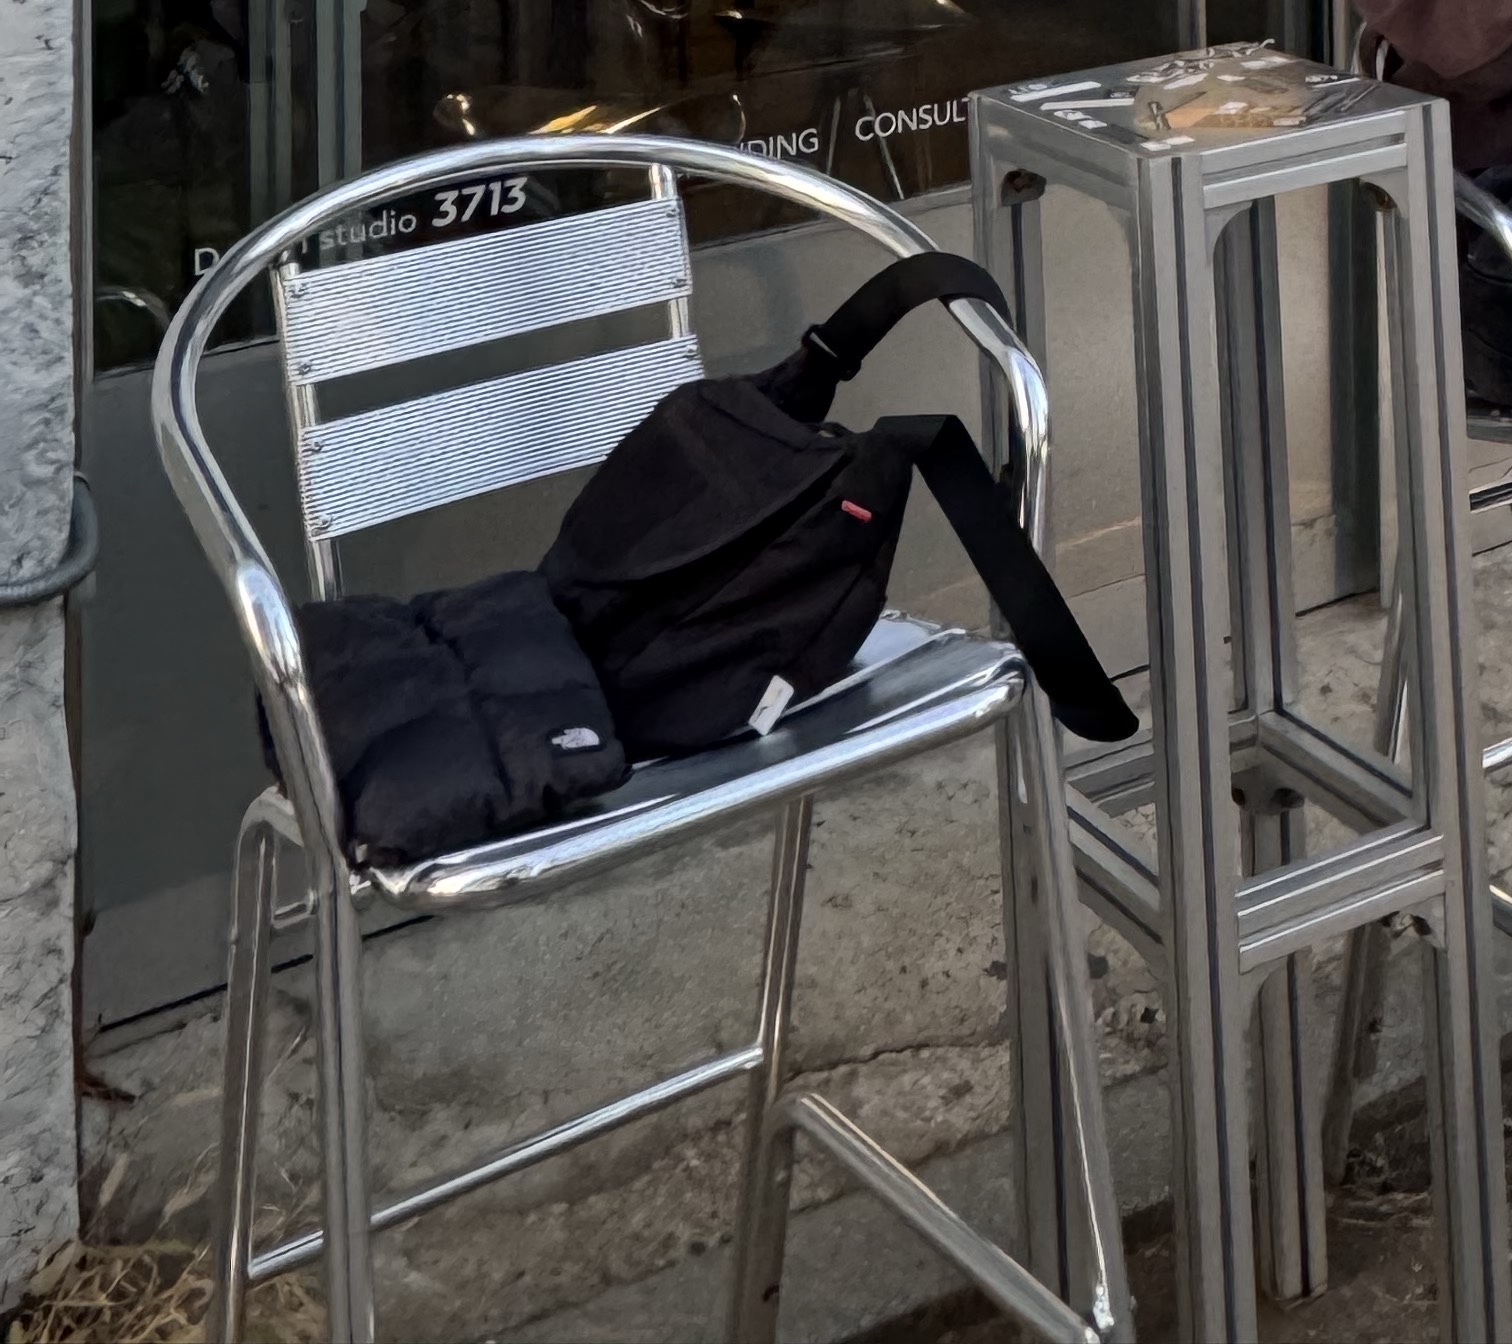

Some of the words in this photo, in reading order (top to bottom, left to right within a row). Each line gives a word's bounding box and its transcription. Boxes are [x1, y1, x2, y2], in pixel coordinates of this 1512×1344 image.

[855, 97, 970, 143] CONSUL
[319, 210, 417, 251] studio
[432, 176, 528, 228] 3713
